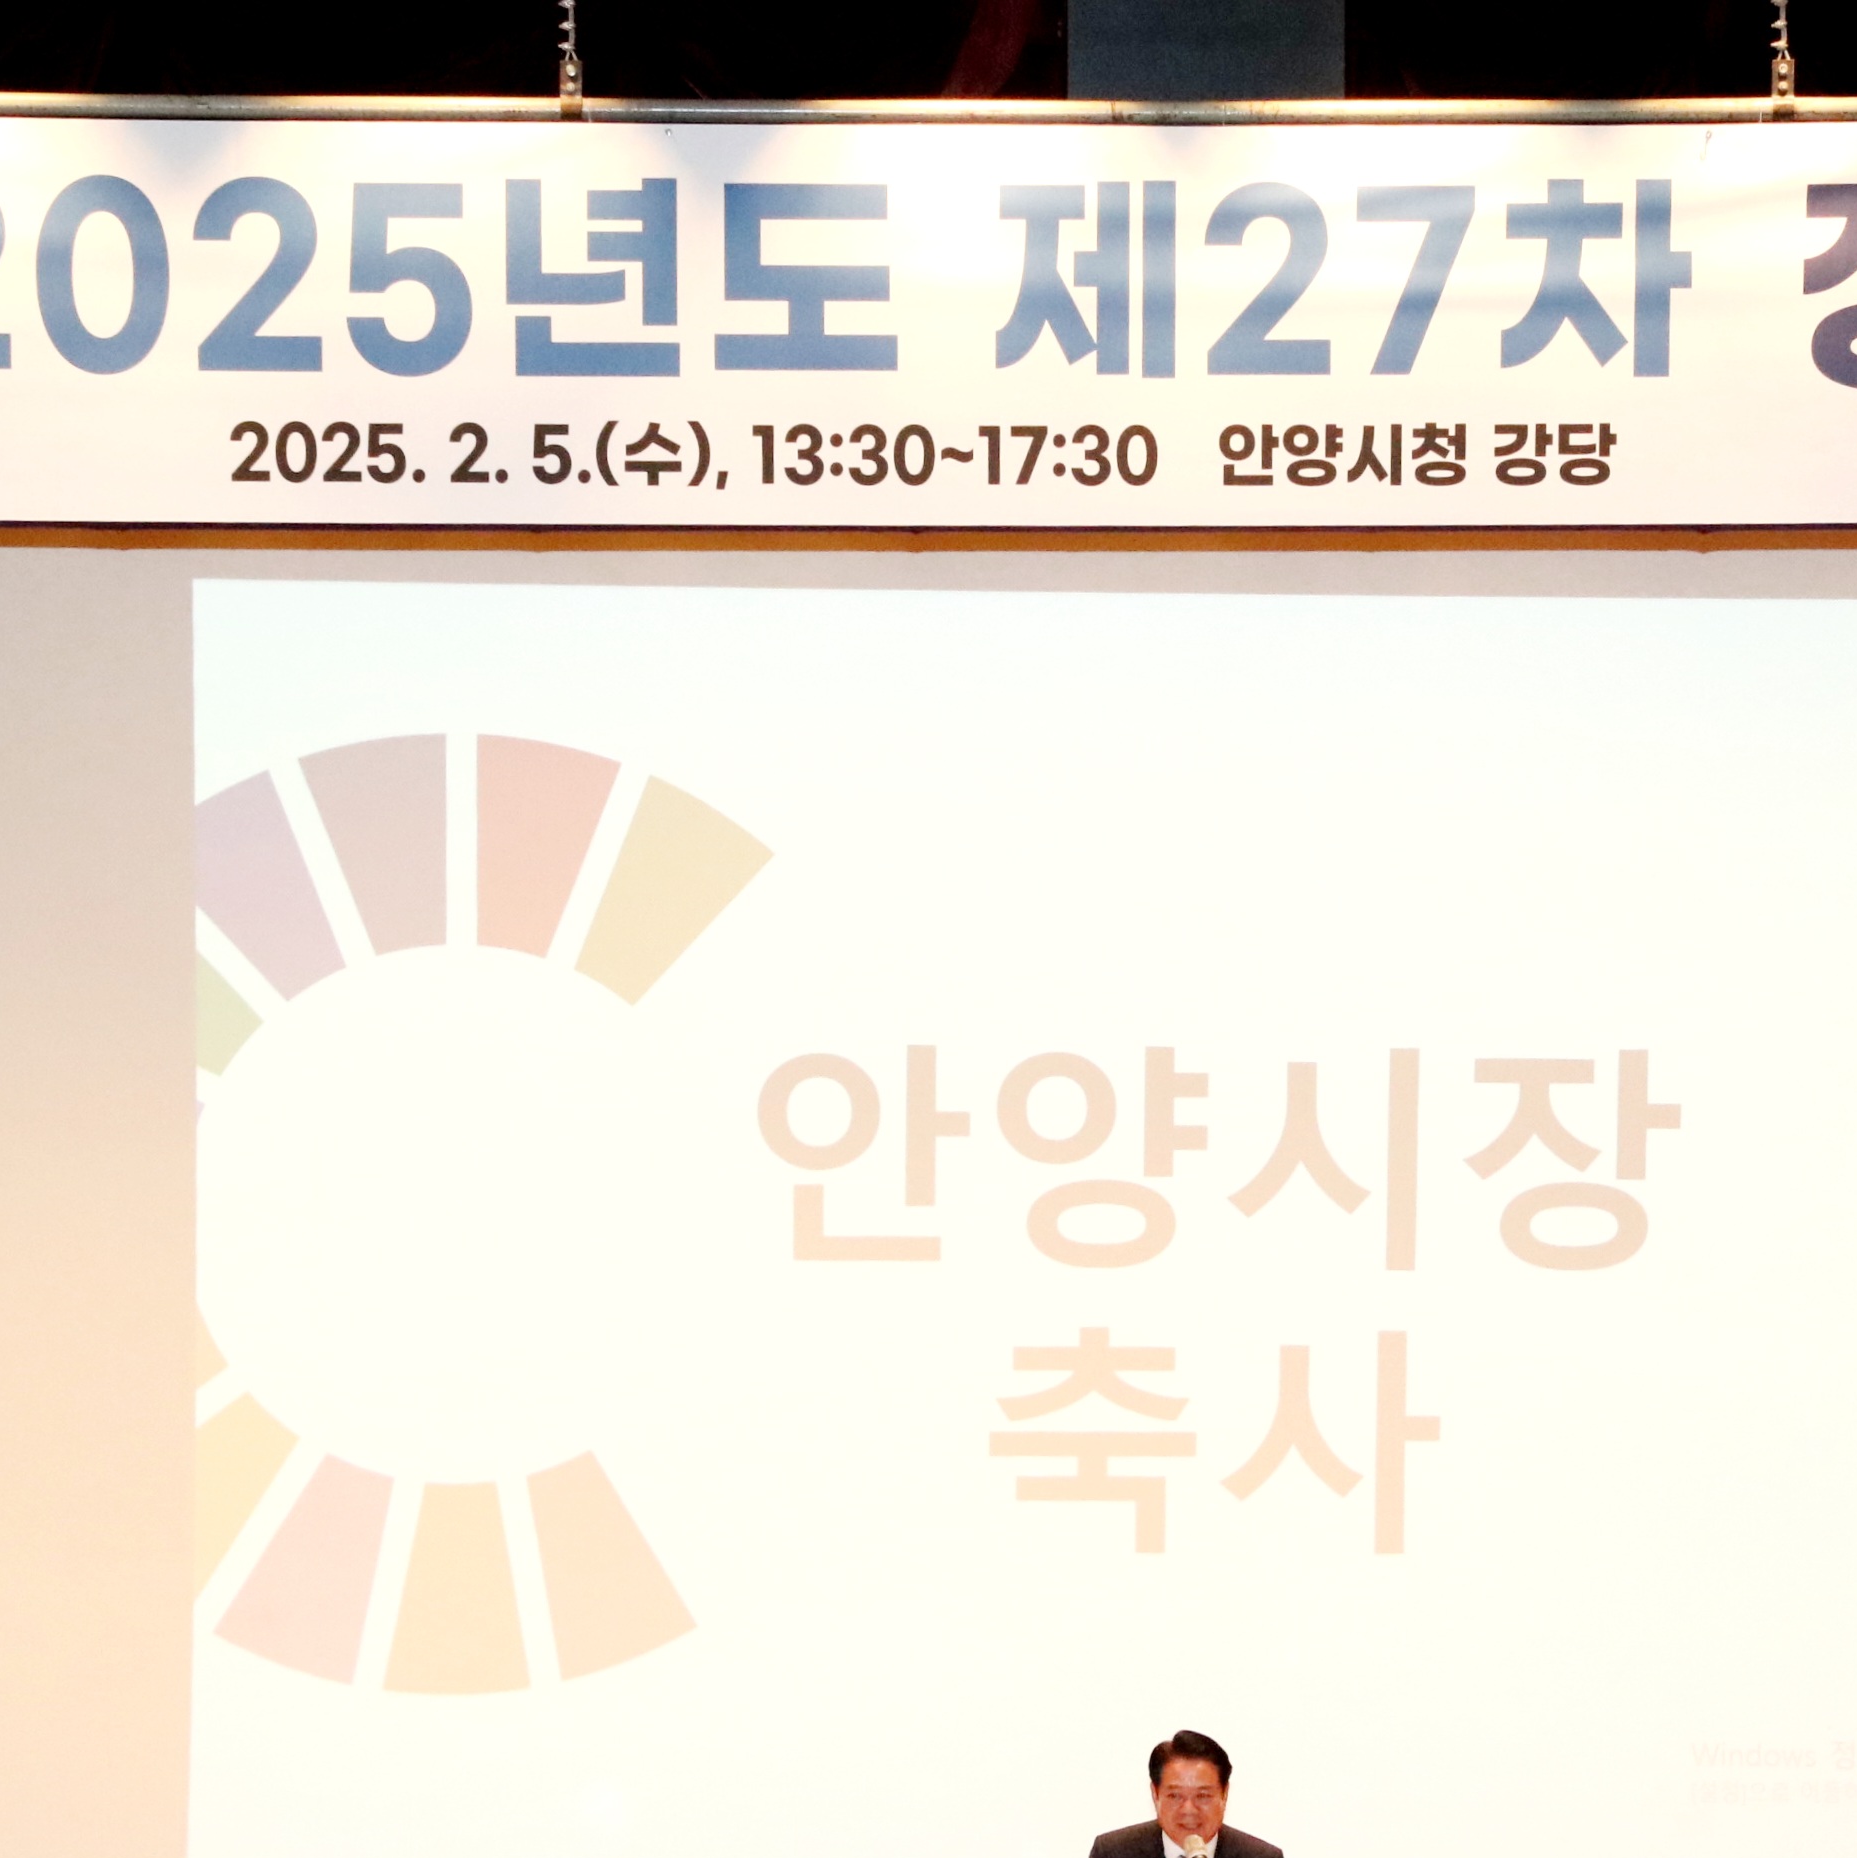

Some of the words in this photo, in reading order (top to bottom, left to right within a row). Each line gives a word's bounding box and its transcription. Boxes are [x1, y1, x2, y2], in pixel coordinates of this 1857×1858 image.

[995, 178, 1693, 379] 제27차
[229, 420, 425, 487] 2025.
[448, 420, 509, 487] 2.
[531, 420, 728, 491] 5.(수),
[753, 422, 1159, 488] 13:30~17:30
[1218, 422, 1468, 488] 안양시청
[1493, 422, 1617, 488] 강당
[757, 1044, 1682, 1271] 안양시장
[989, 1327, 1442, 1555] 축사
[1691, 1741, 1816, 1768] Windows
